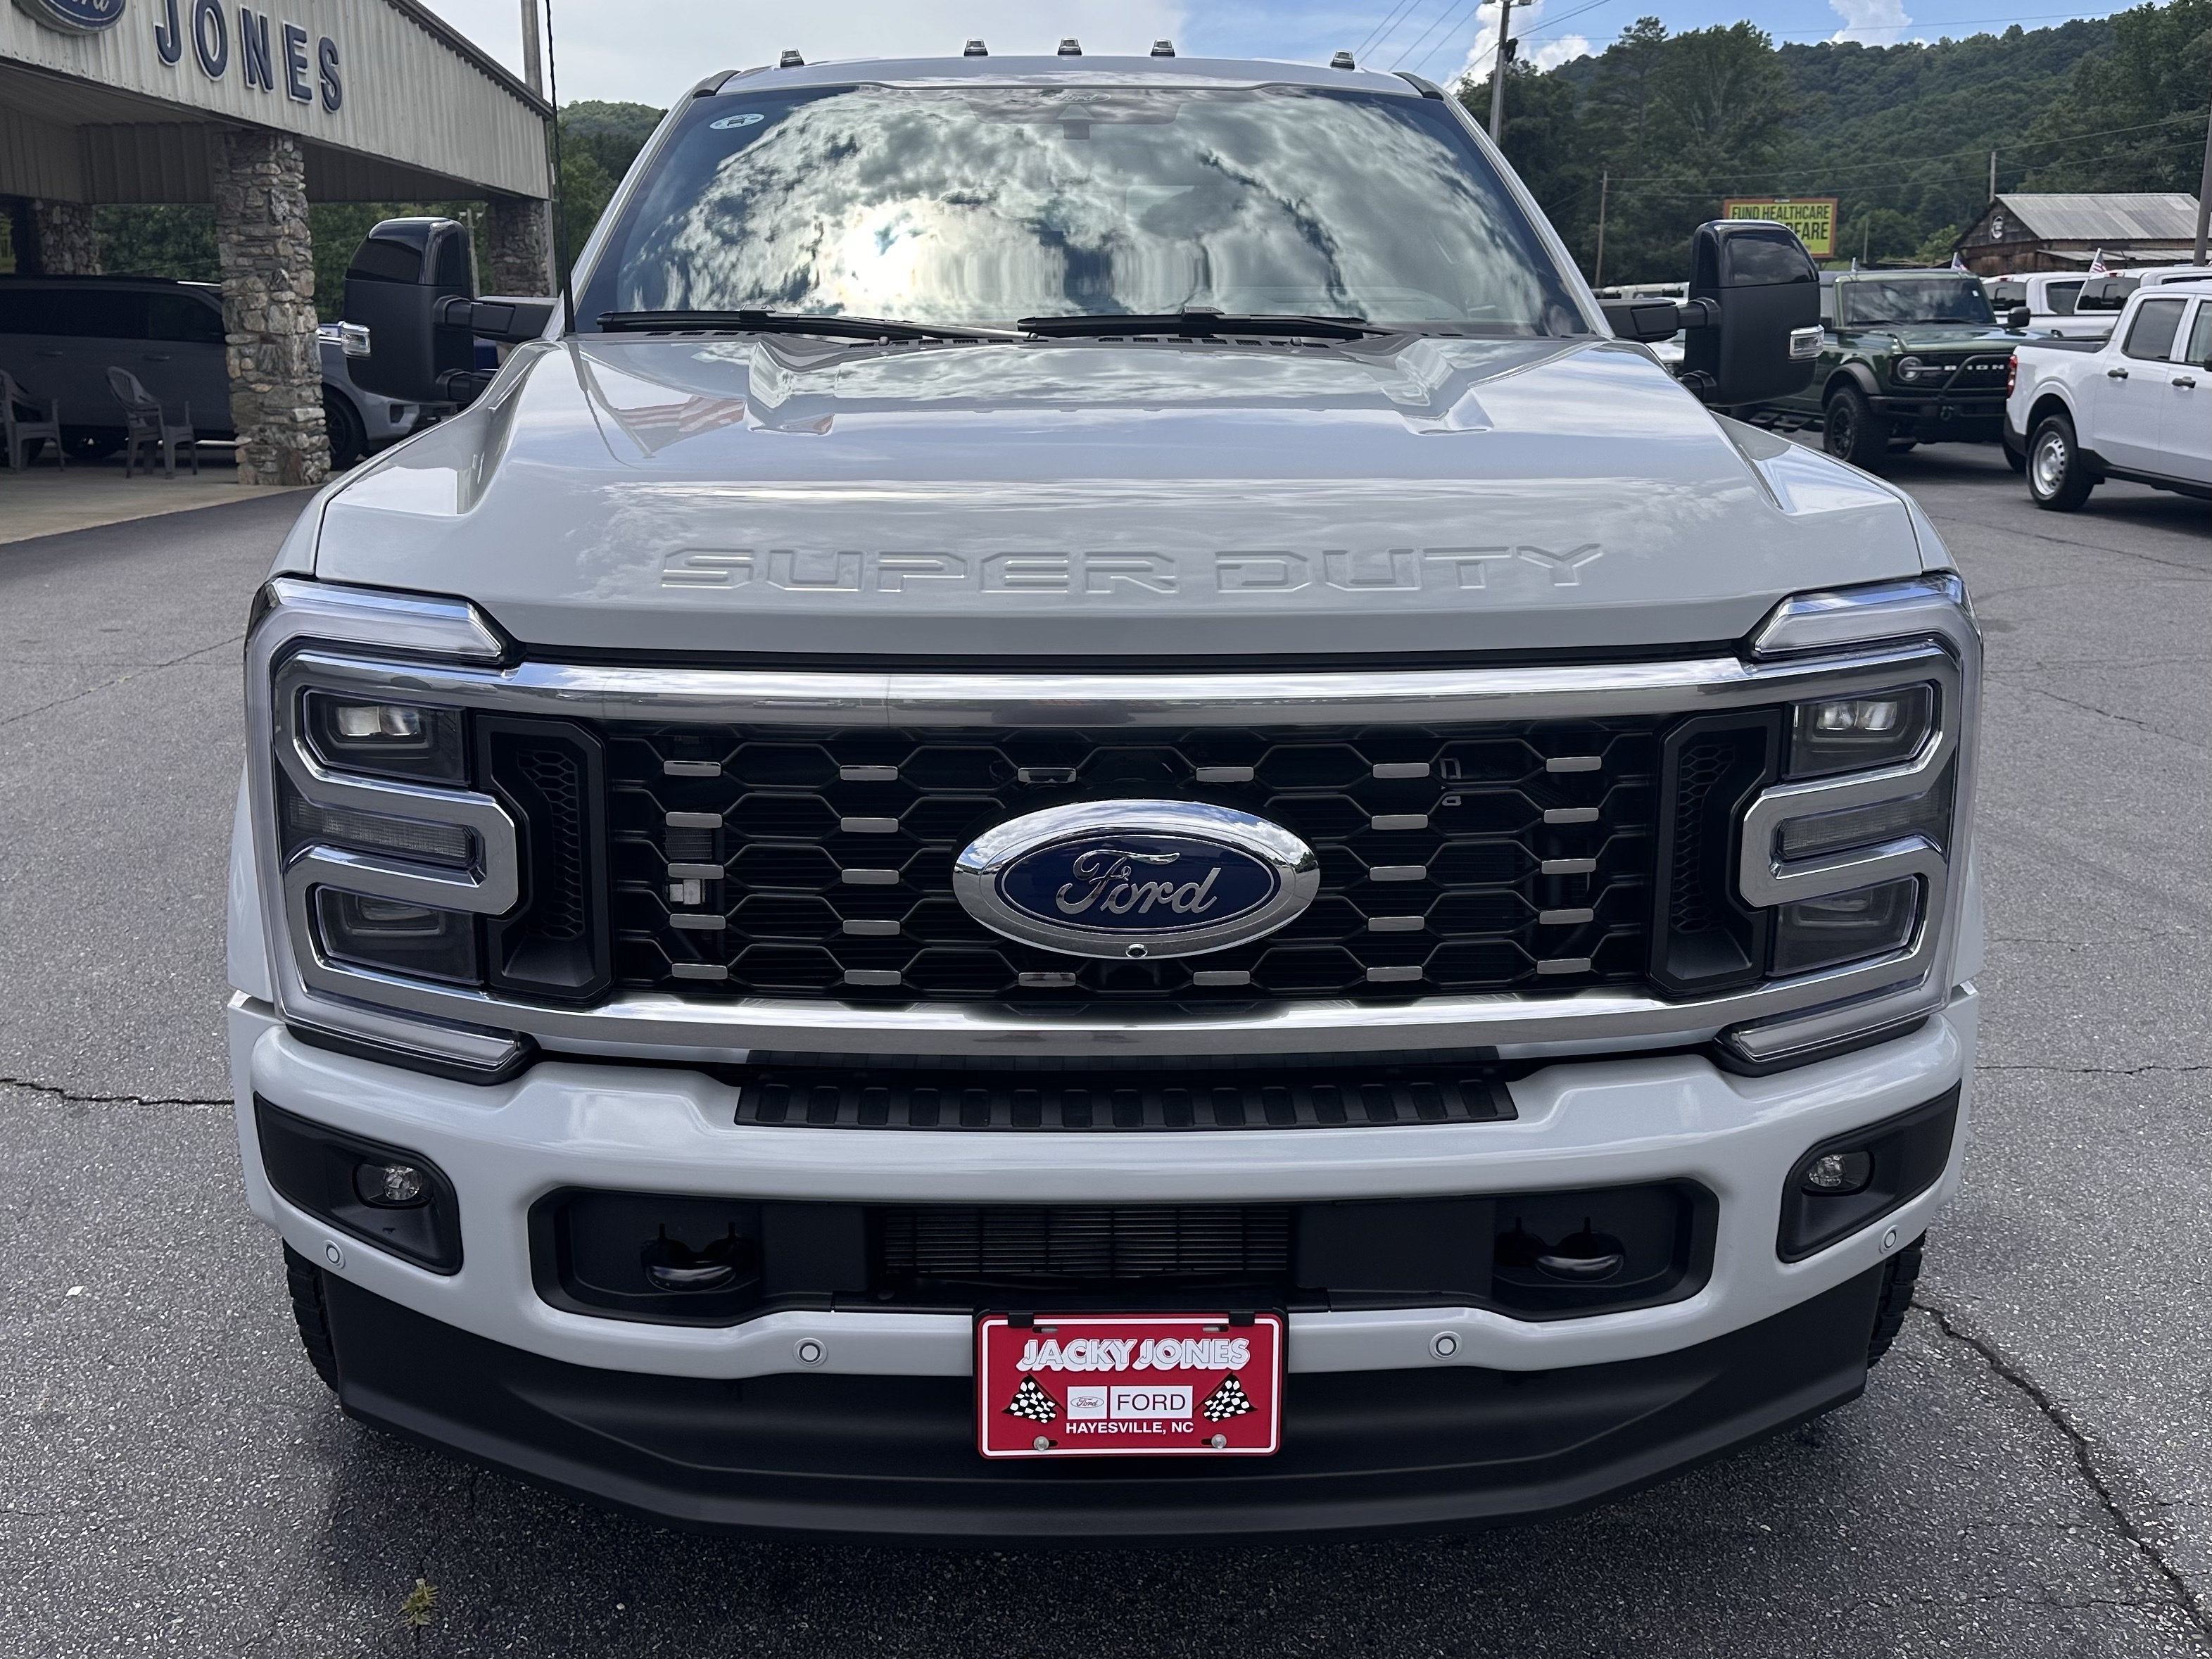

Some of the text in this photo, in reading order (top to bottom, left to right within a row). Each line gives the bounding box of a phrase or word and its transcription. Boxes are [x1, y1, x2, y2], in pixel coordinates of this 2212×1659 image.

[153, 0, 343, 113] JONES
[1732, 206, 1831, 220] FUND HEALTHCARE
[662, 543, 1604, 594] SUPER DUTY
[1056, 849, 1222, 915] Ford
[1016, 1337, 1251, 1372] JACKY JONES
[1076, 1396, 1099, 1407] Ford
[1118, 1394, 1186, 1411] FORD
[1066, 1421, 1194, 1434] HAYESVILLE, NC
